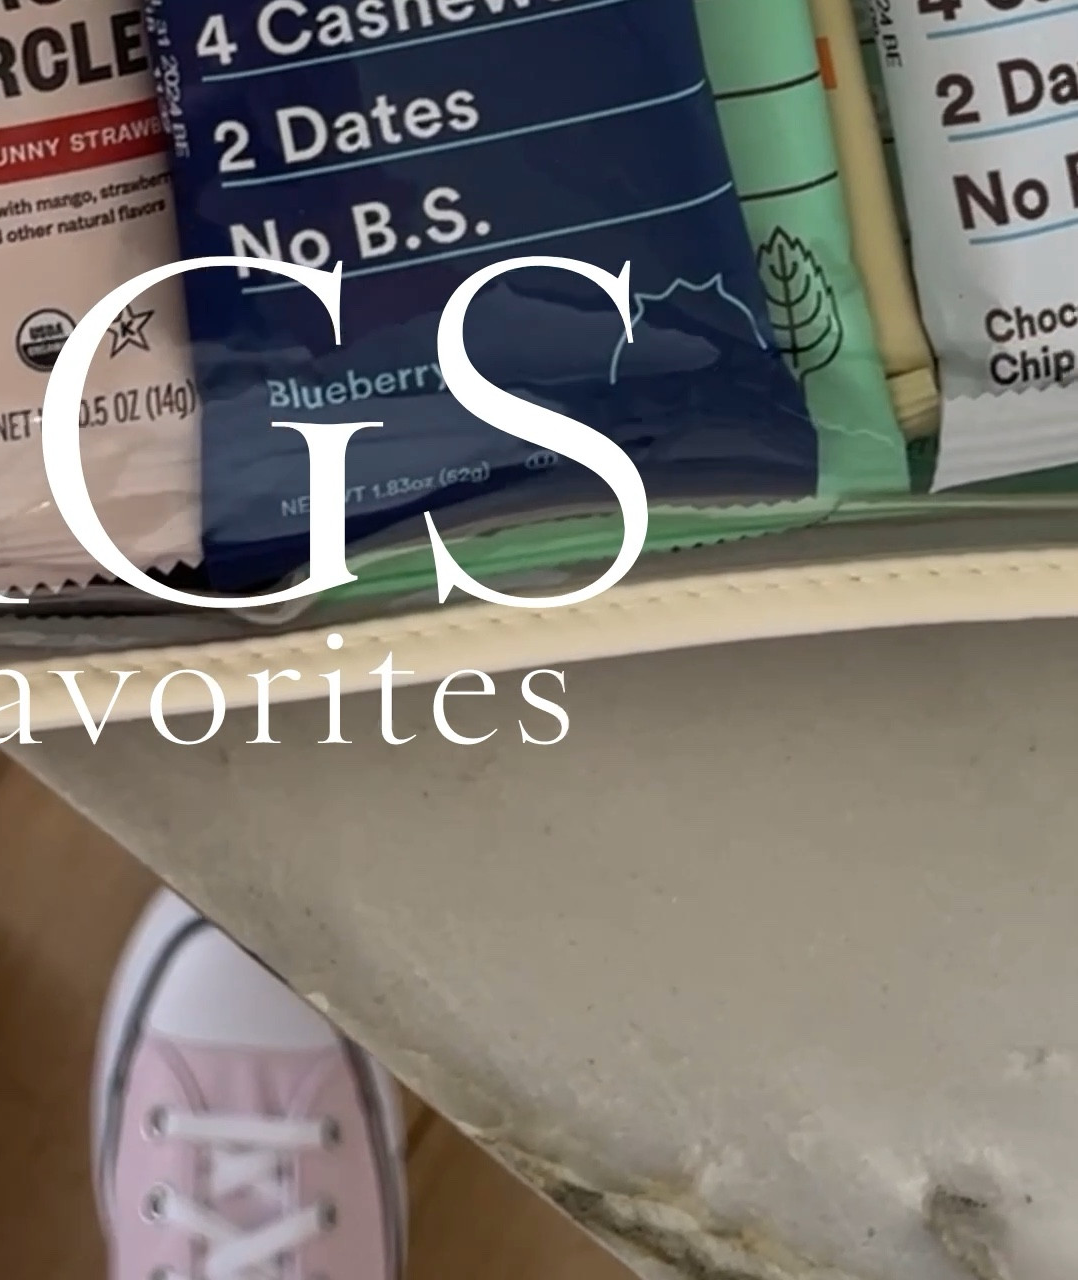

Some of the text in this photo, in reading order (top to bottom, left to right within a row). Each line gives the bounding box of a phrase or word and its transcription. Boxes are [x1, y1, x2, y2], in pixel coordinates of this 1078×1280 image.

[194, 13, 239, 68] 4
[935, 72, 982, 129] 2
[212, 86, 482, 173] 2 Dates
[6, 222, 54, 244] other
[56, 207, 117, 235] natural
[117, 198, 167, 224] flavors
[35, 190, 99, 214] mango,
[952, 168, 1051, 231] No
[229, 184, 492, 280] No B.S.
[266, 360, 450, 411] Blueberry
[989, 347, 1077, 388] Chip
[113, 389, 142, 424] OZ
[145, 377, 198, 422] (14g)
